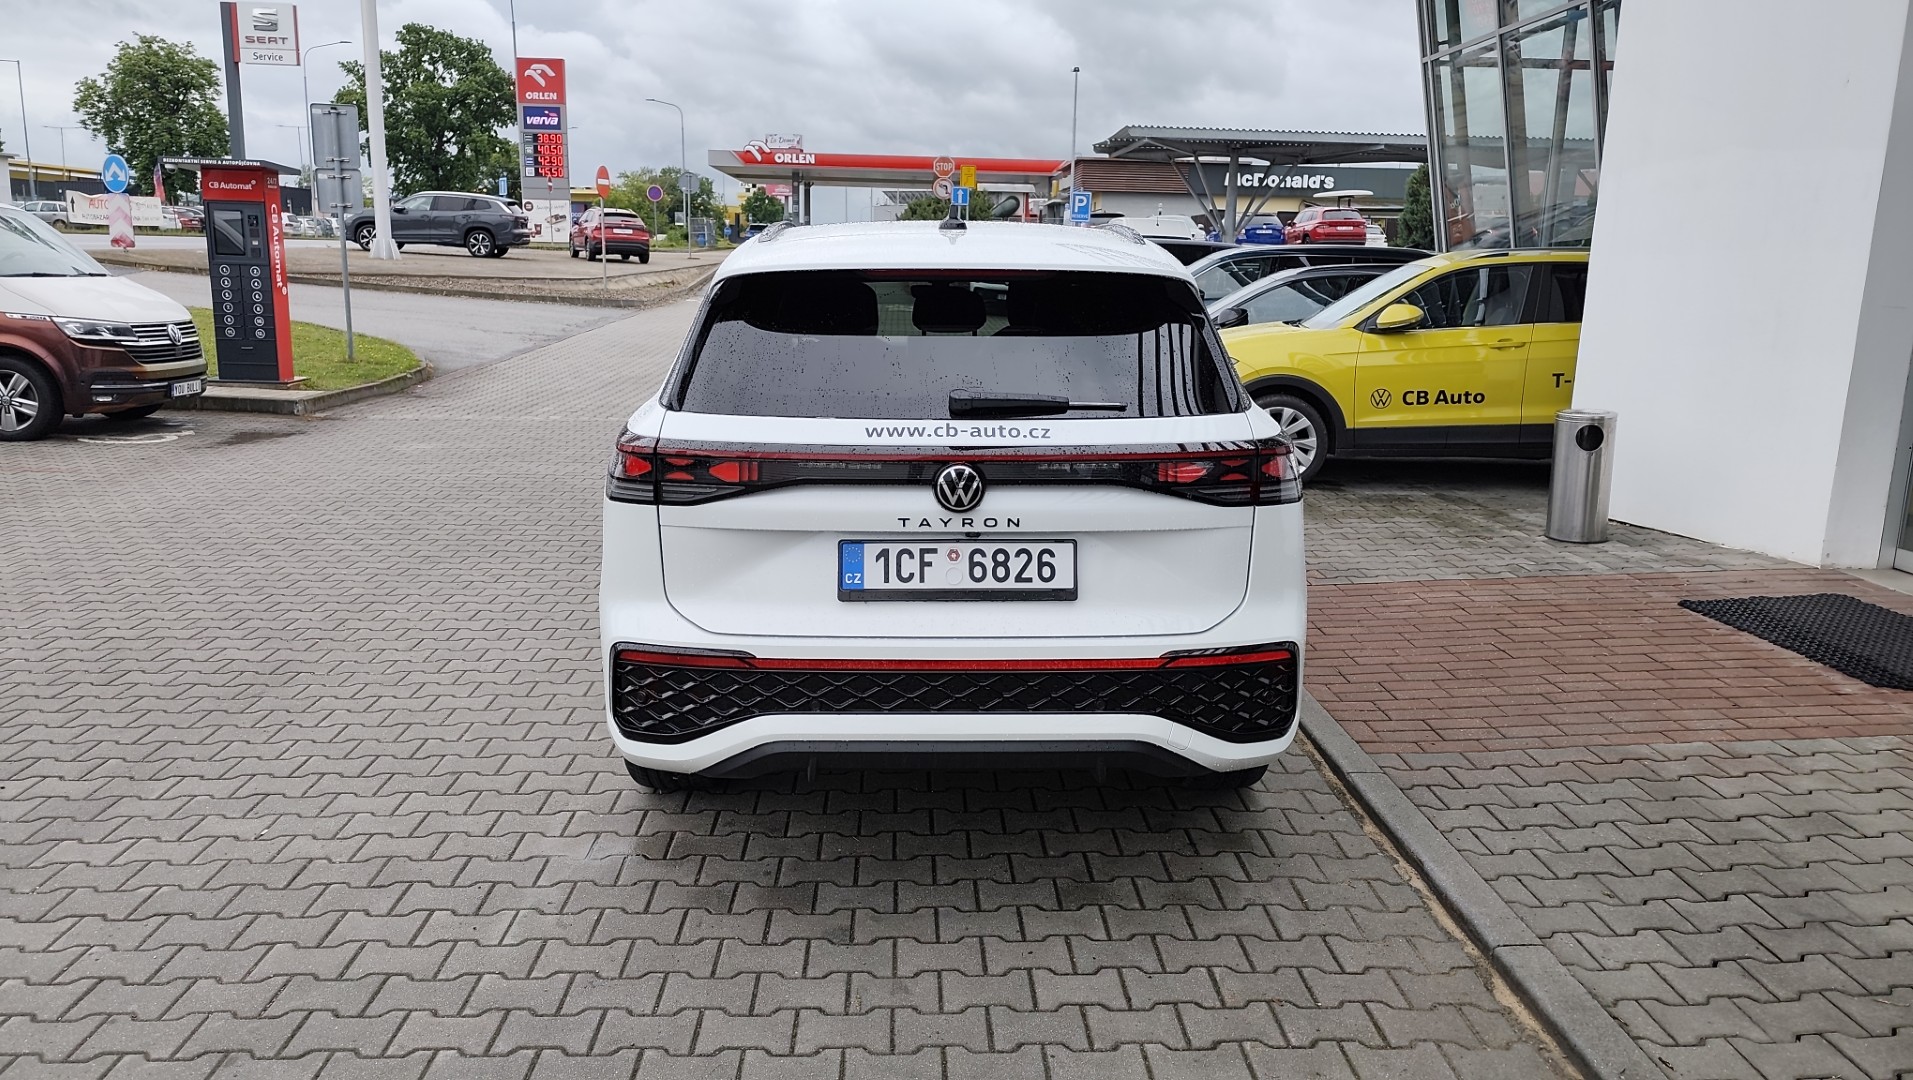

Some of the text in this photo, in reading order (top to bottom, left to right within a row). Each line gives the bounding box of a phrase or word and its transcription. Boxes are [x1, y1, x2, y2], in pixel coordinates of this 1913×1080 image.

[245, 35, 288, 45] SEAT
[252, 51, 284, 61] Service
[525, 91, 558, 100] ORLEN
[526, 115, 559, 125] verva
[537, 133, 563, 144] 38.90
[537, 145, 563, 155] 40.50
[538, 155, 564, 167] 42.90
[774, 152, 816, 164] ORLEN
[936, 162, 953, 171] STOP
[538, 167, 564, 178] 45.50
[208, 181, 253, 191] CB Automat
[1074, 194, 1087, 213] P
[272, 225, 284, 288] Automat
[1402, 389, 1486, 406] CB Auto
[865, 422, 1051, 439] www.cb-auto.cz
[897, 517, 1021, 528] TAYRON
[845, 547, 1057, 584] CZ 1CF 6826
